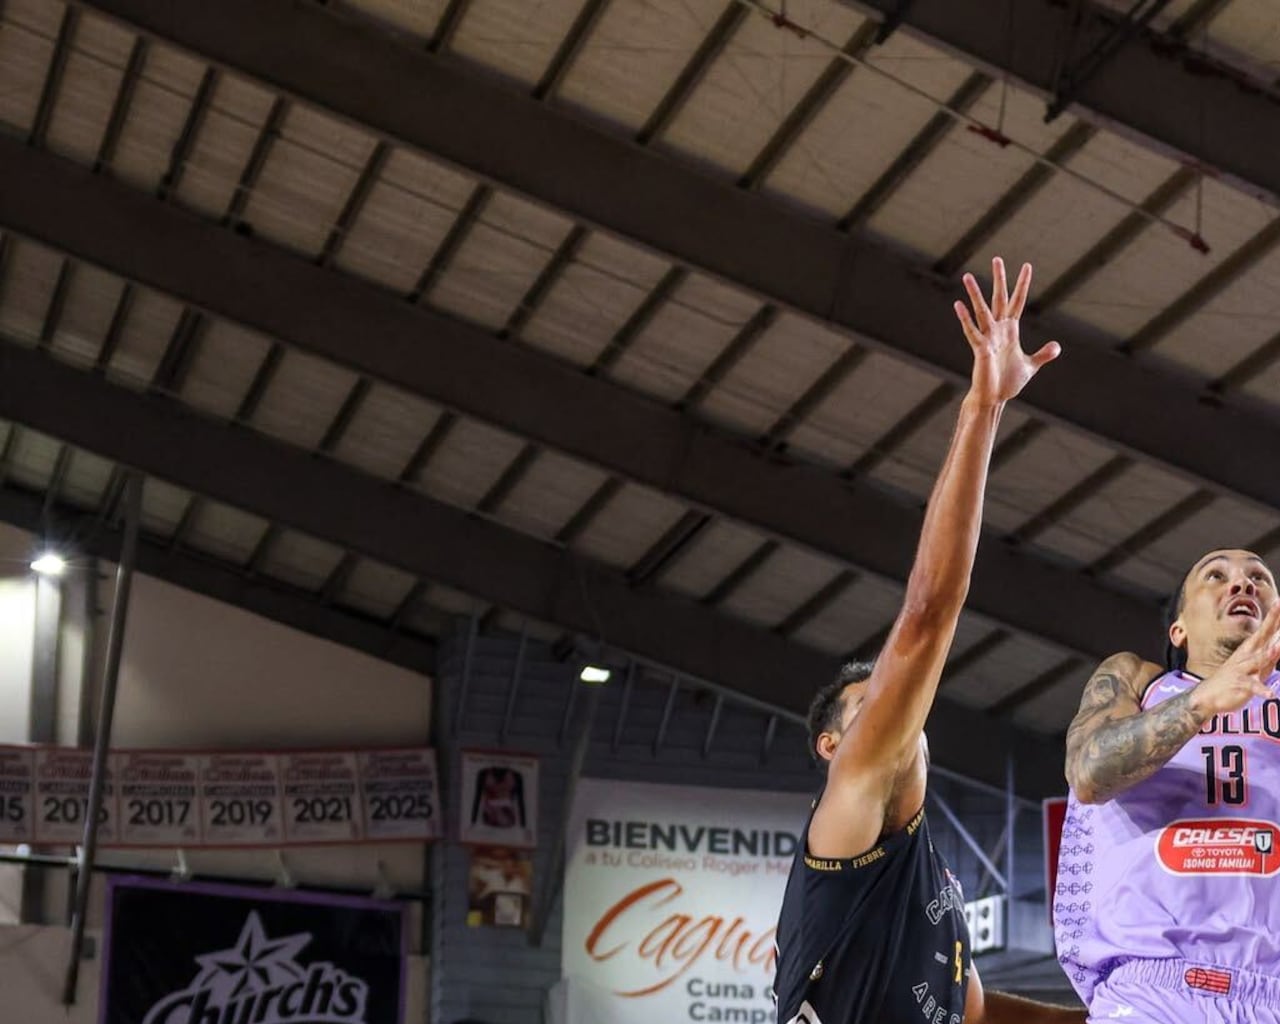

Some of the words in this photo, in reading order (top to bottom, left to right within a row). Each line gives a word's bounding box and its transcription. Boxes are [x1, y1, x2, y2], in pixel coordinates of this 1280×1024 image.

[1201, 745, 1246, 804] 13
[129, 800, 190, 825] 2017
[210, 799, 272, 825] 2019
[294, 798, 352, 822] 2021
[370, 796, 433, 820] 2025
[1173, 827, 1257, 847] CALESA
[852, 848, 886, 868] FIEBRE
[1207, 848, 1244, 856] TOYOTA
[703, 858, 758, 876] Roger
[687, 978, 753, 1001] Cuna
